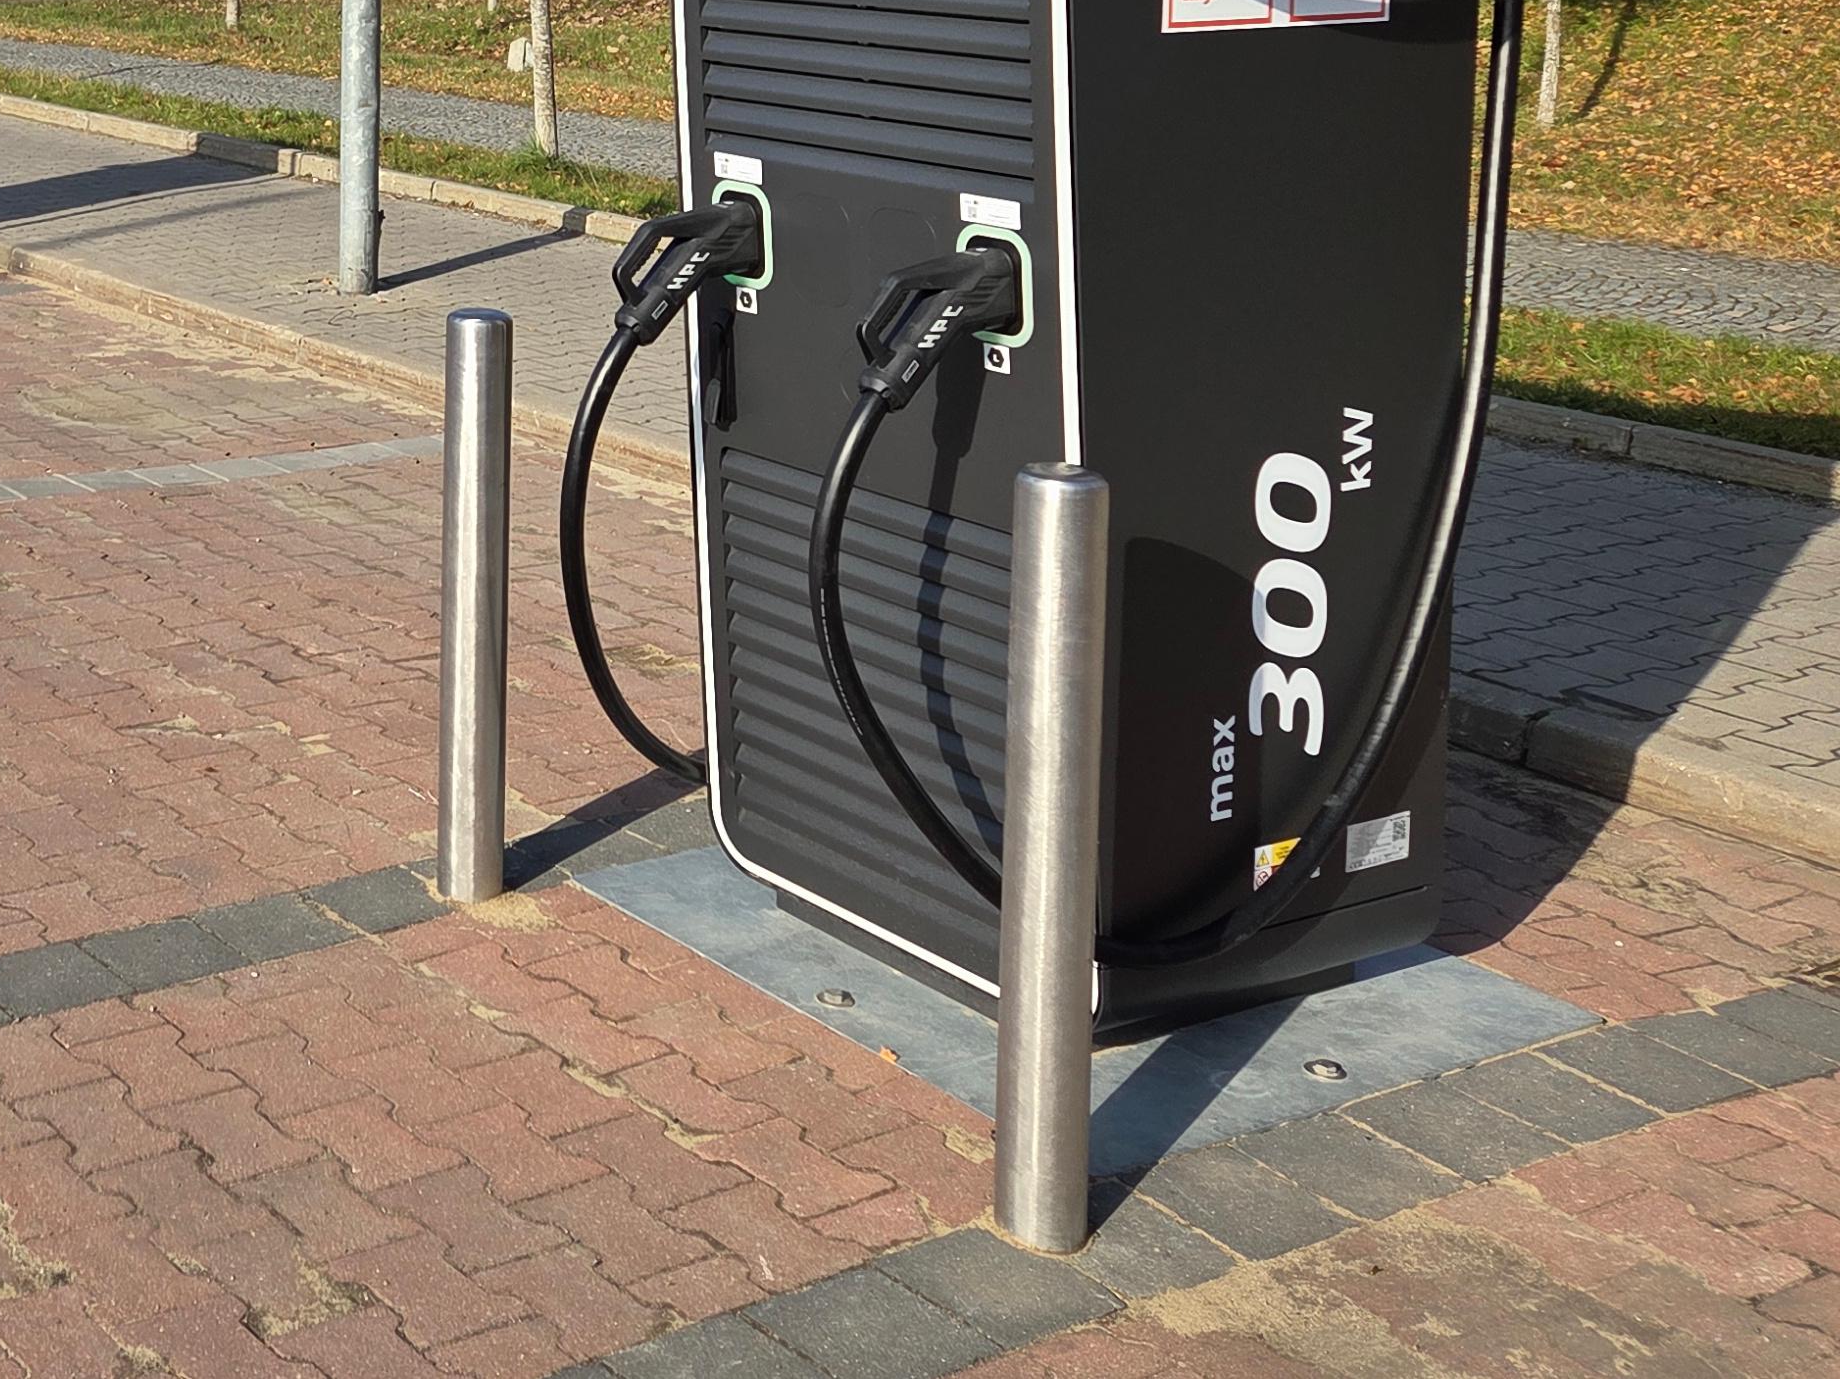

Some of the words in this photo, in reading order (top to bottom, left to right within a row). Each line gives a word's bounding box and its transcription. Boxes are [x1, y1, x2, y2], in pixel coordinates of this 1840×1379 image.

[666, 251, 711, 290] HPC
[917, 305, 964, 349] HPC
[1210, 714, 1236, 823] max
[1247, 452, 1332, 757] 300
[1339, 406, 1374, 493] kW
